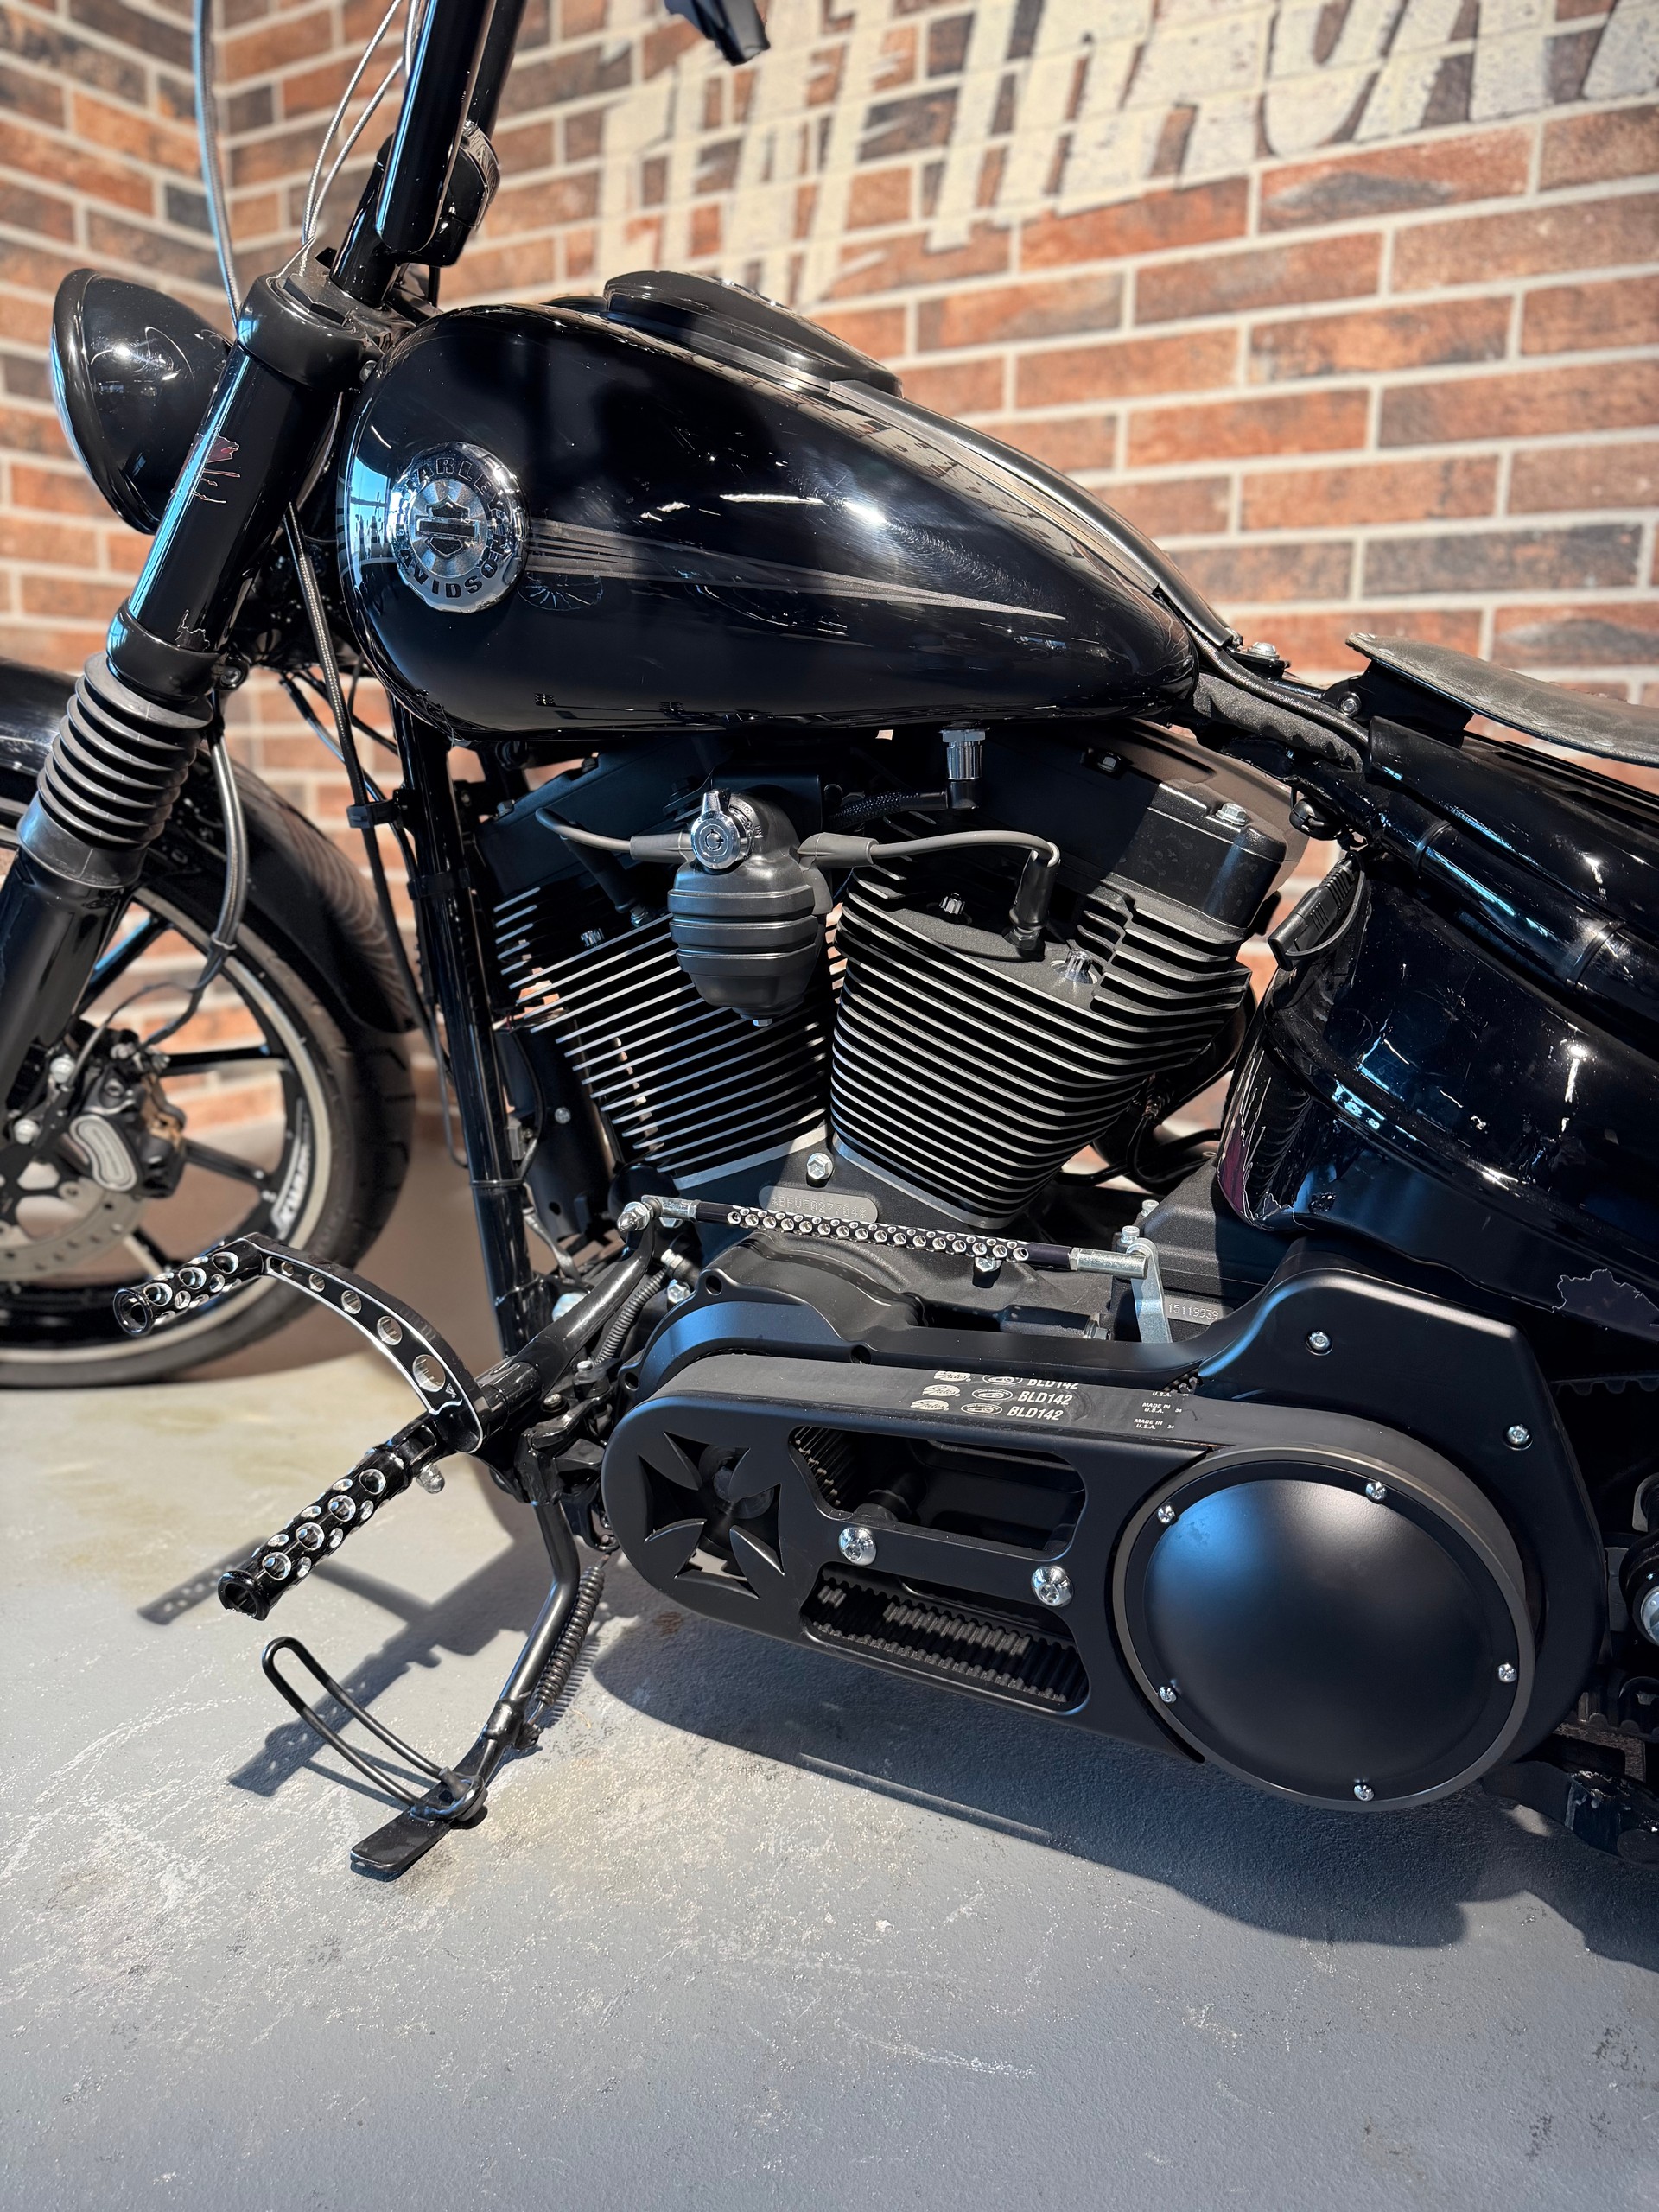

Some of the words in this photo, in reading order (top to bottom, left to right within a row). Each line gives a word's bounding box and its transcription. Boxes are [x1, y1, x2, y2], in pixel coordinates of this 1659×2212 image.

[741, 804, 753, 814] ACC
[1168, 1303, 1219, 1320] 15119939
[1017, 1390, 1073, 1405] BLD142
[1007, 1406, 1064, 1421] BLD142
